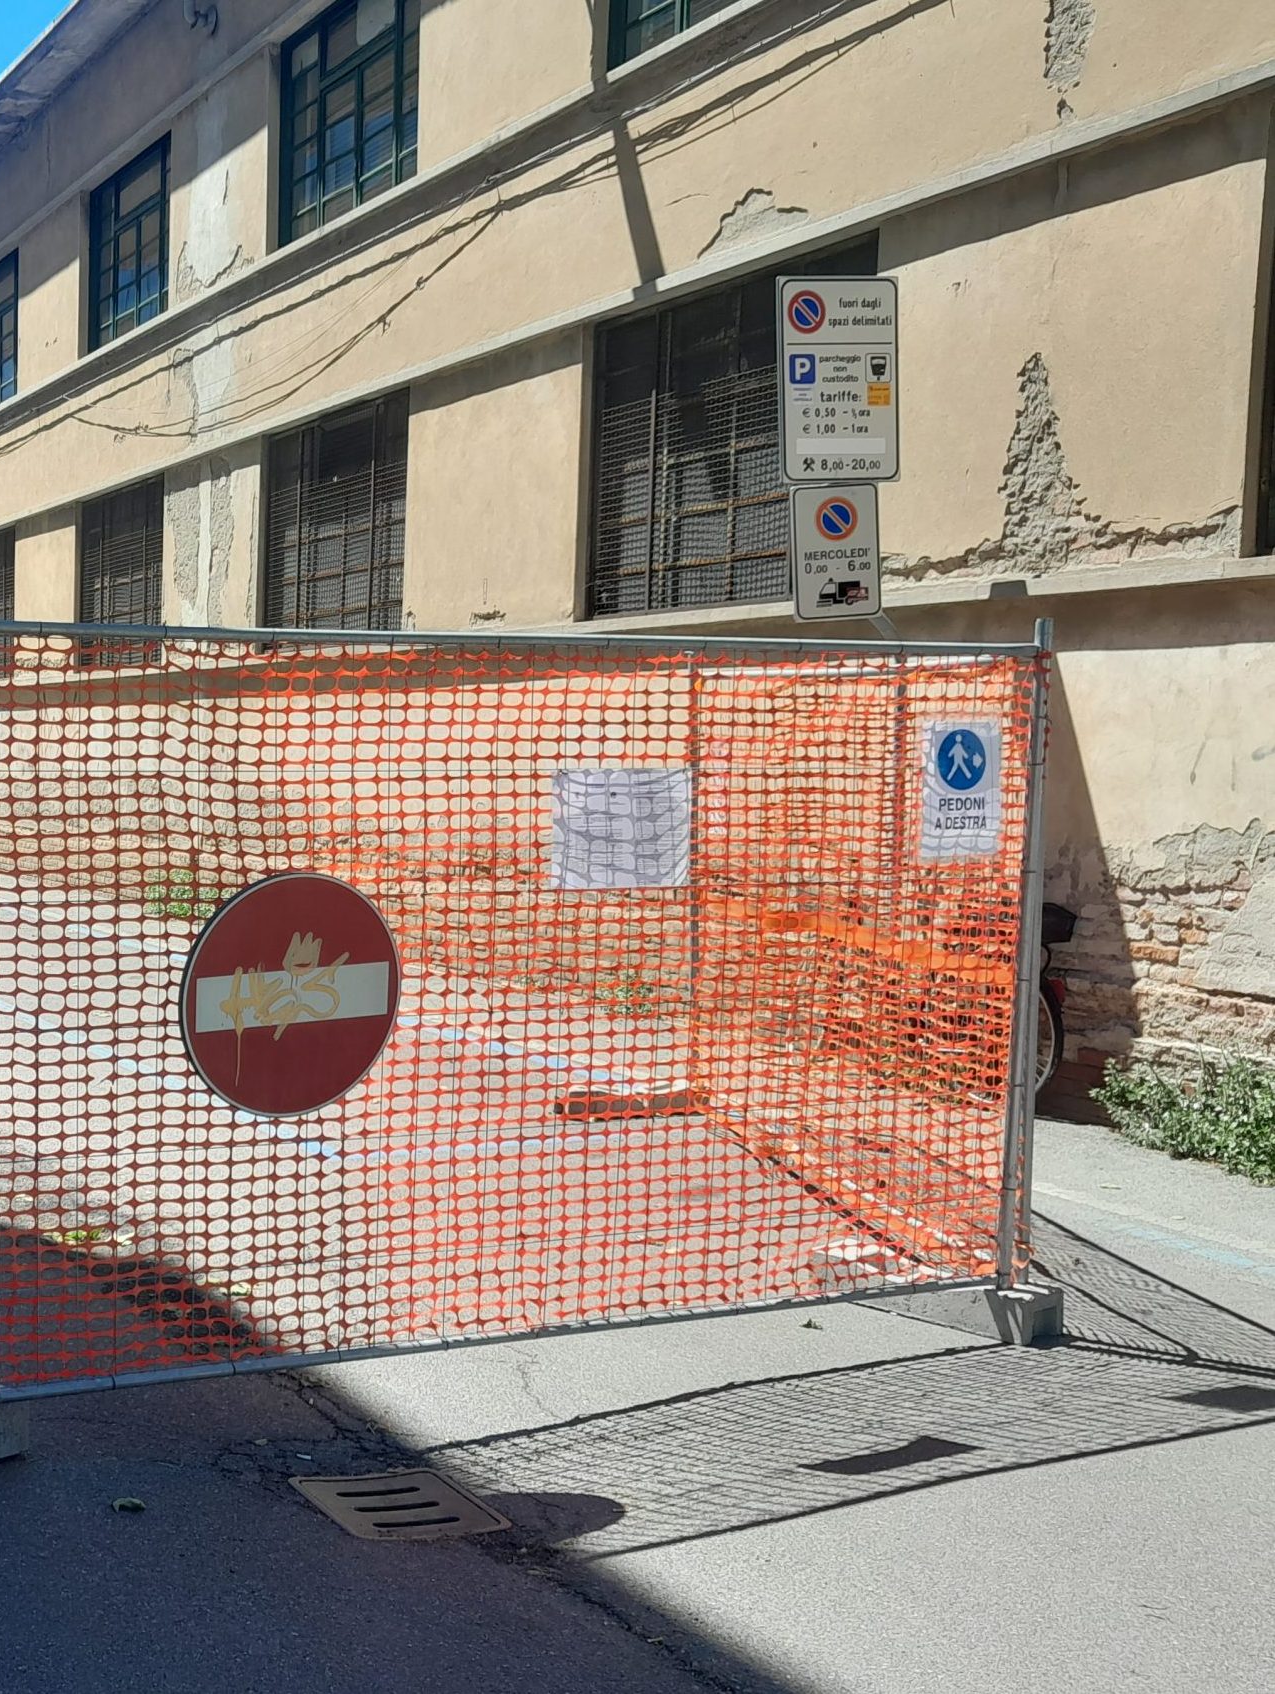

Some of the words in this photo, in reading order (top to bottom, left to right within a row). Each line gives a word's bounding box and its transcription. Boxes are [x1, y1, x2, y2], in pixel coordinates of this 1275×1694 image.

[839, 298, 859, 308] fuori
[861, 297, 882, 310] dagli
[828, 316, 849, 328] spazi
[851, 315, 892, 327] delimitati
[819, 354, 861, 363] parcheggio
[794, 357, 811, 381] P
[833, 365, 847, 373] non
[822, 374, 859, 383] custodito
[820, 391, 862, 403] tariffe:
[814, 407, 836, 419] 0,50
[816, 423, 836, 435] 1,00
[939, 797, 985, 811] PEDONI
[935, 818, 942, 831] A
[944, 815, 987, 830] DESTRA
